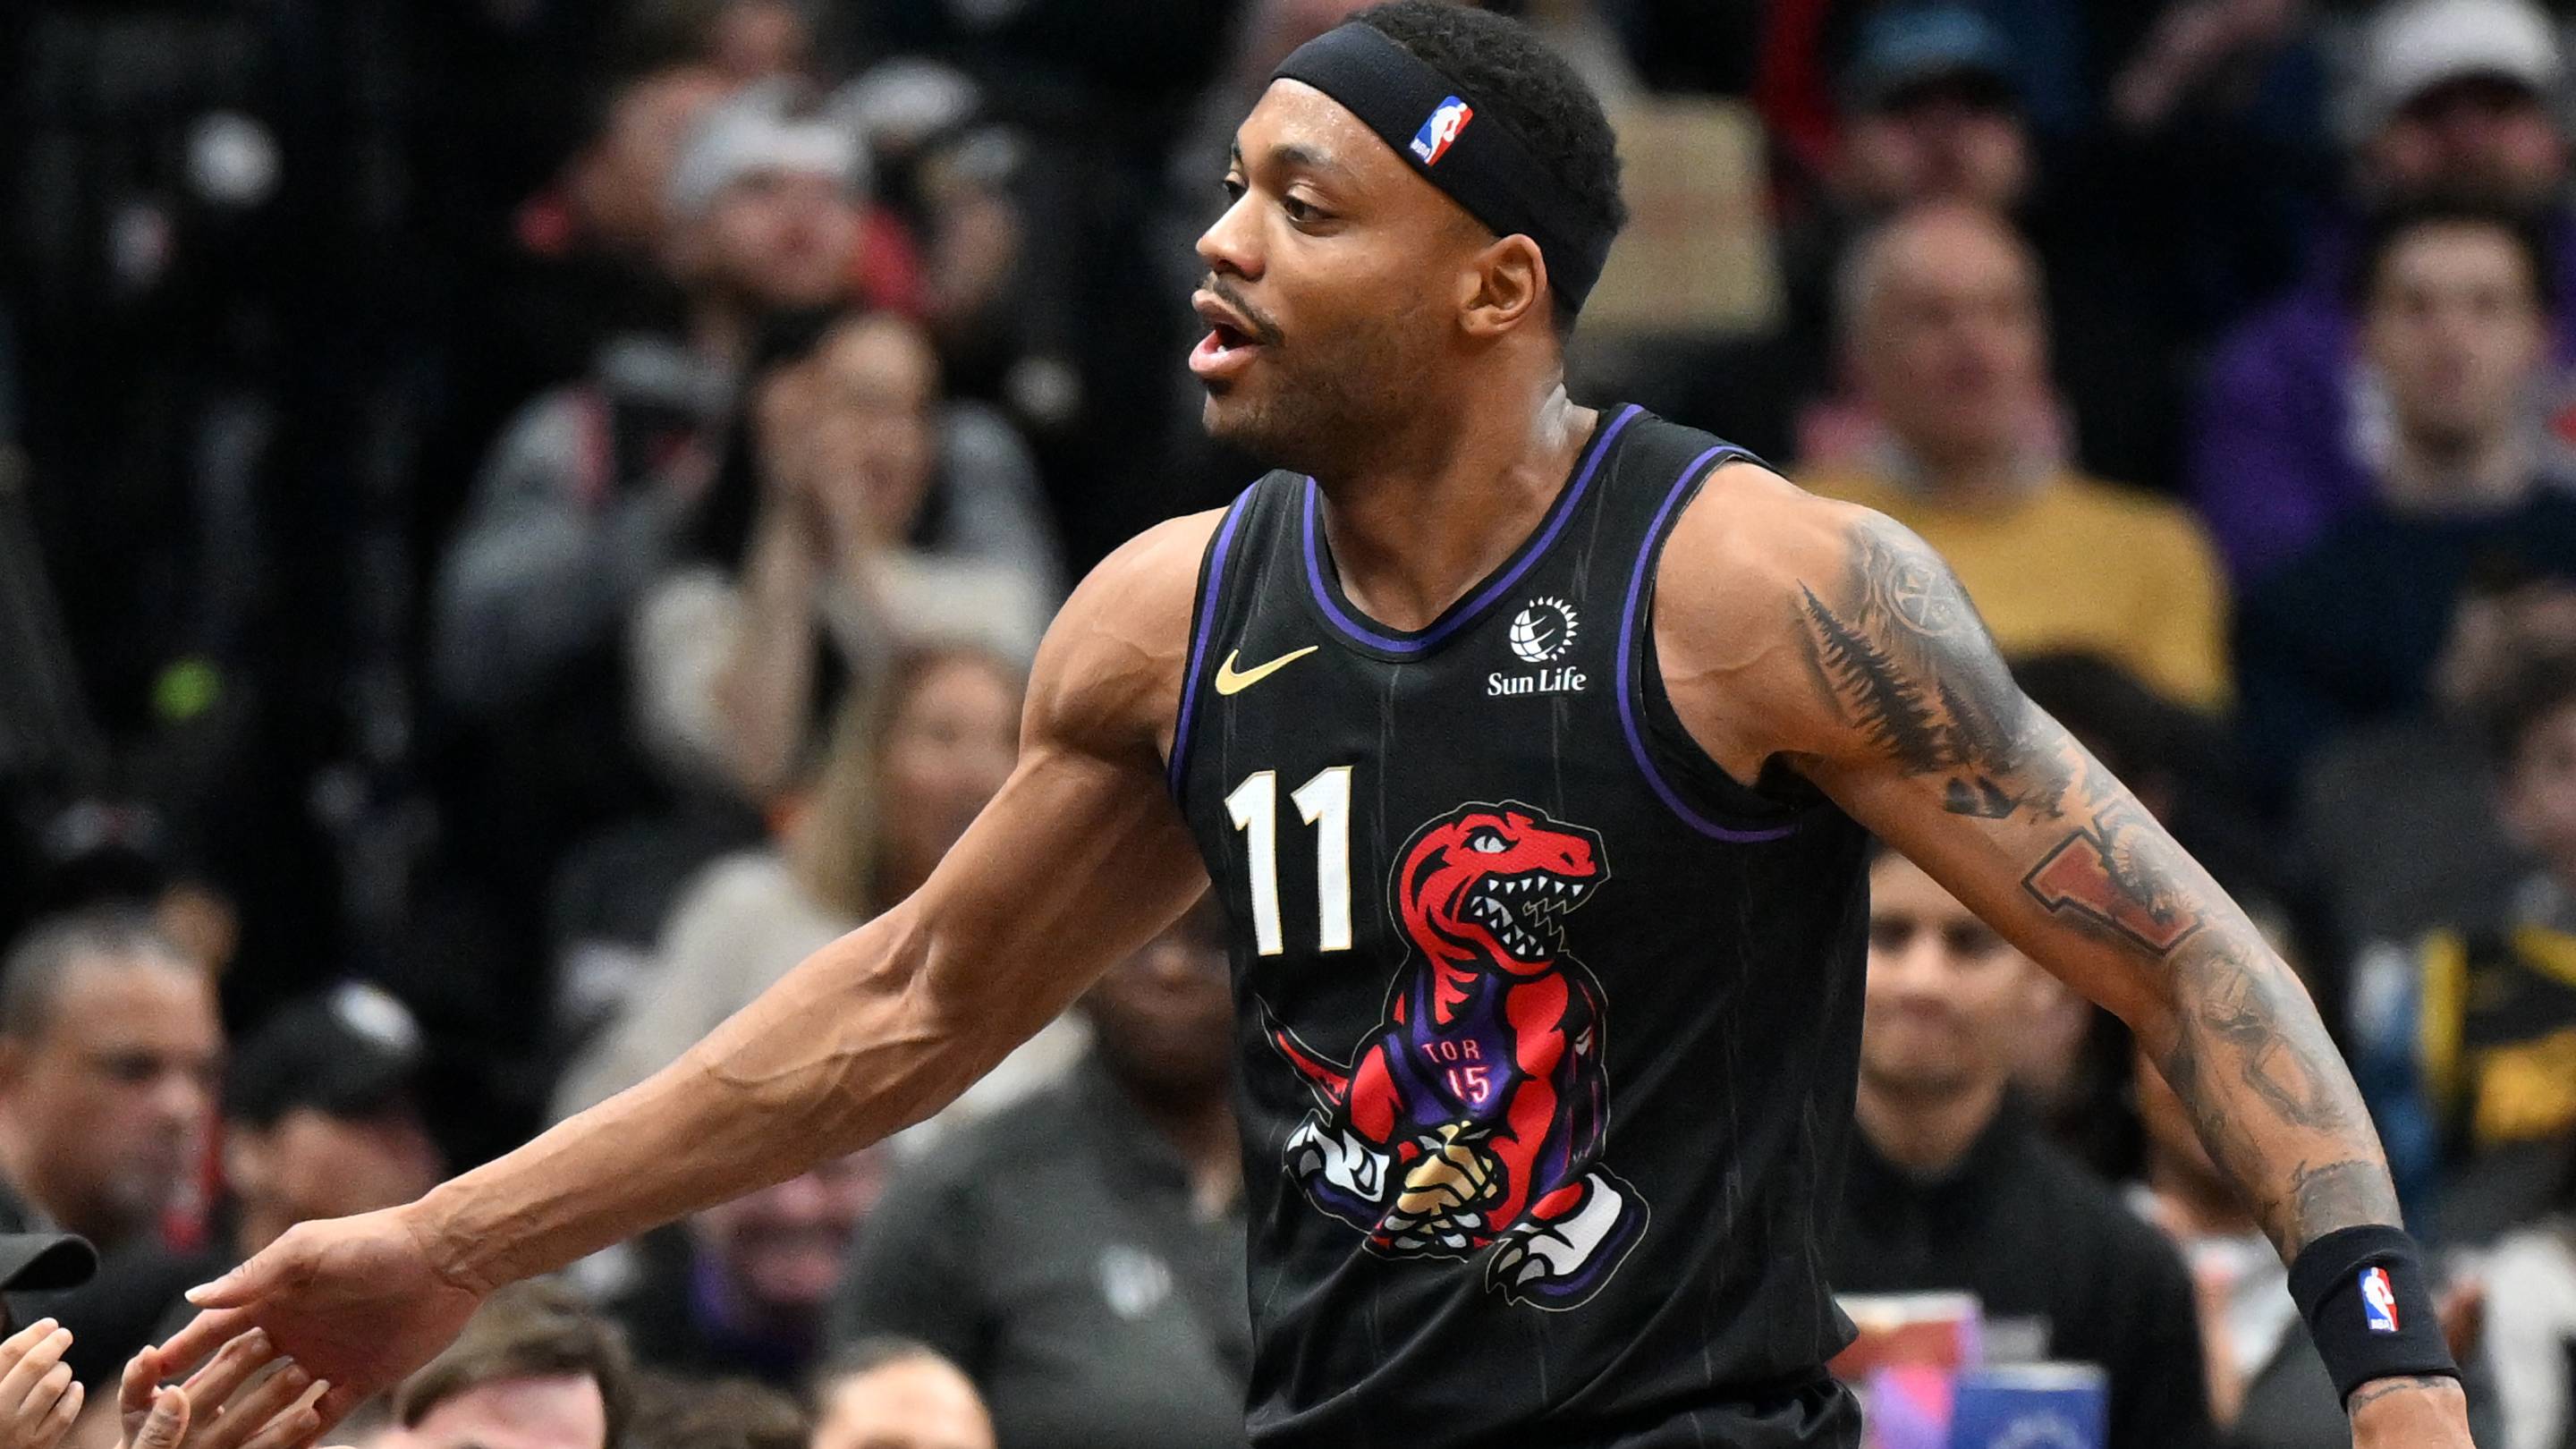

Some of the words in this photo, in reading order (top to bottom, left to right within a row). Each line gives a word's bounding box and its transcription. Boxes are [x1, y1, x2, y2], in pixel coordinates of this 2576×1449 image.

[1487, 672, 1534, 696] Sun
[1538, 666, 1587, 691] Life
[1224, 766, 1353, 956] 11
[1421, 1039, 1481, 1064] TOR
[1447, 1065, 1490, 1104] 15
